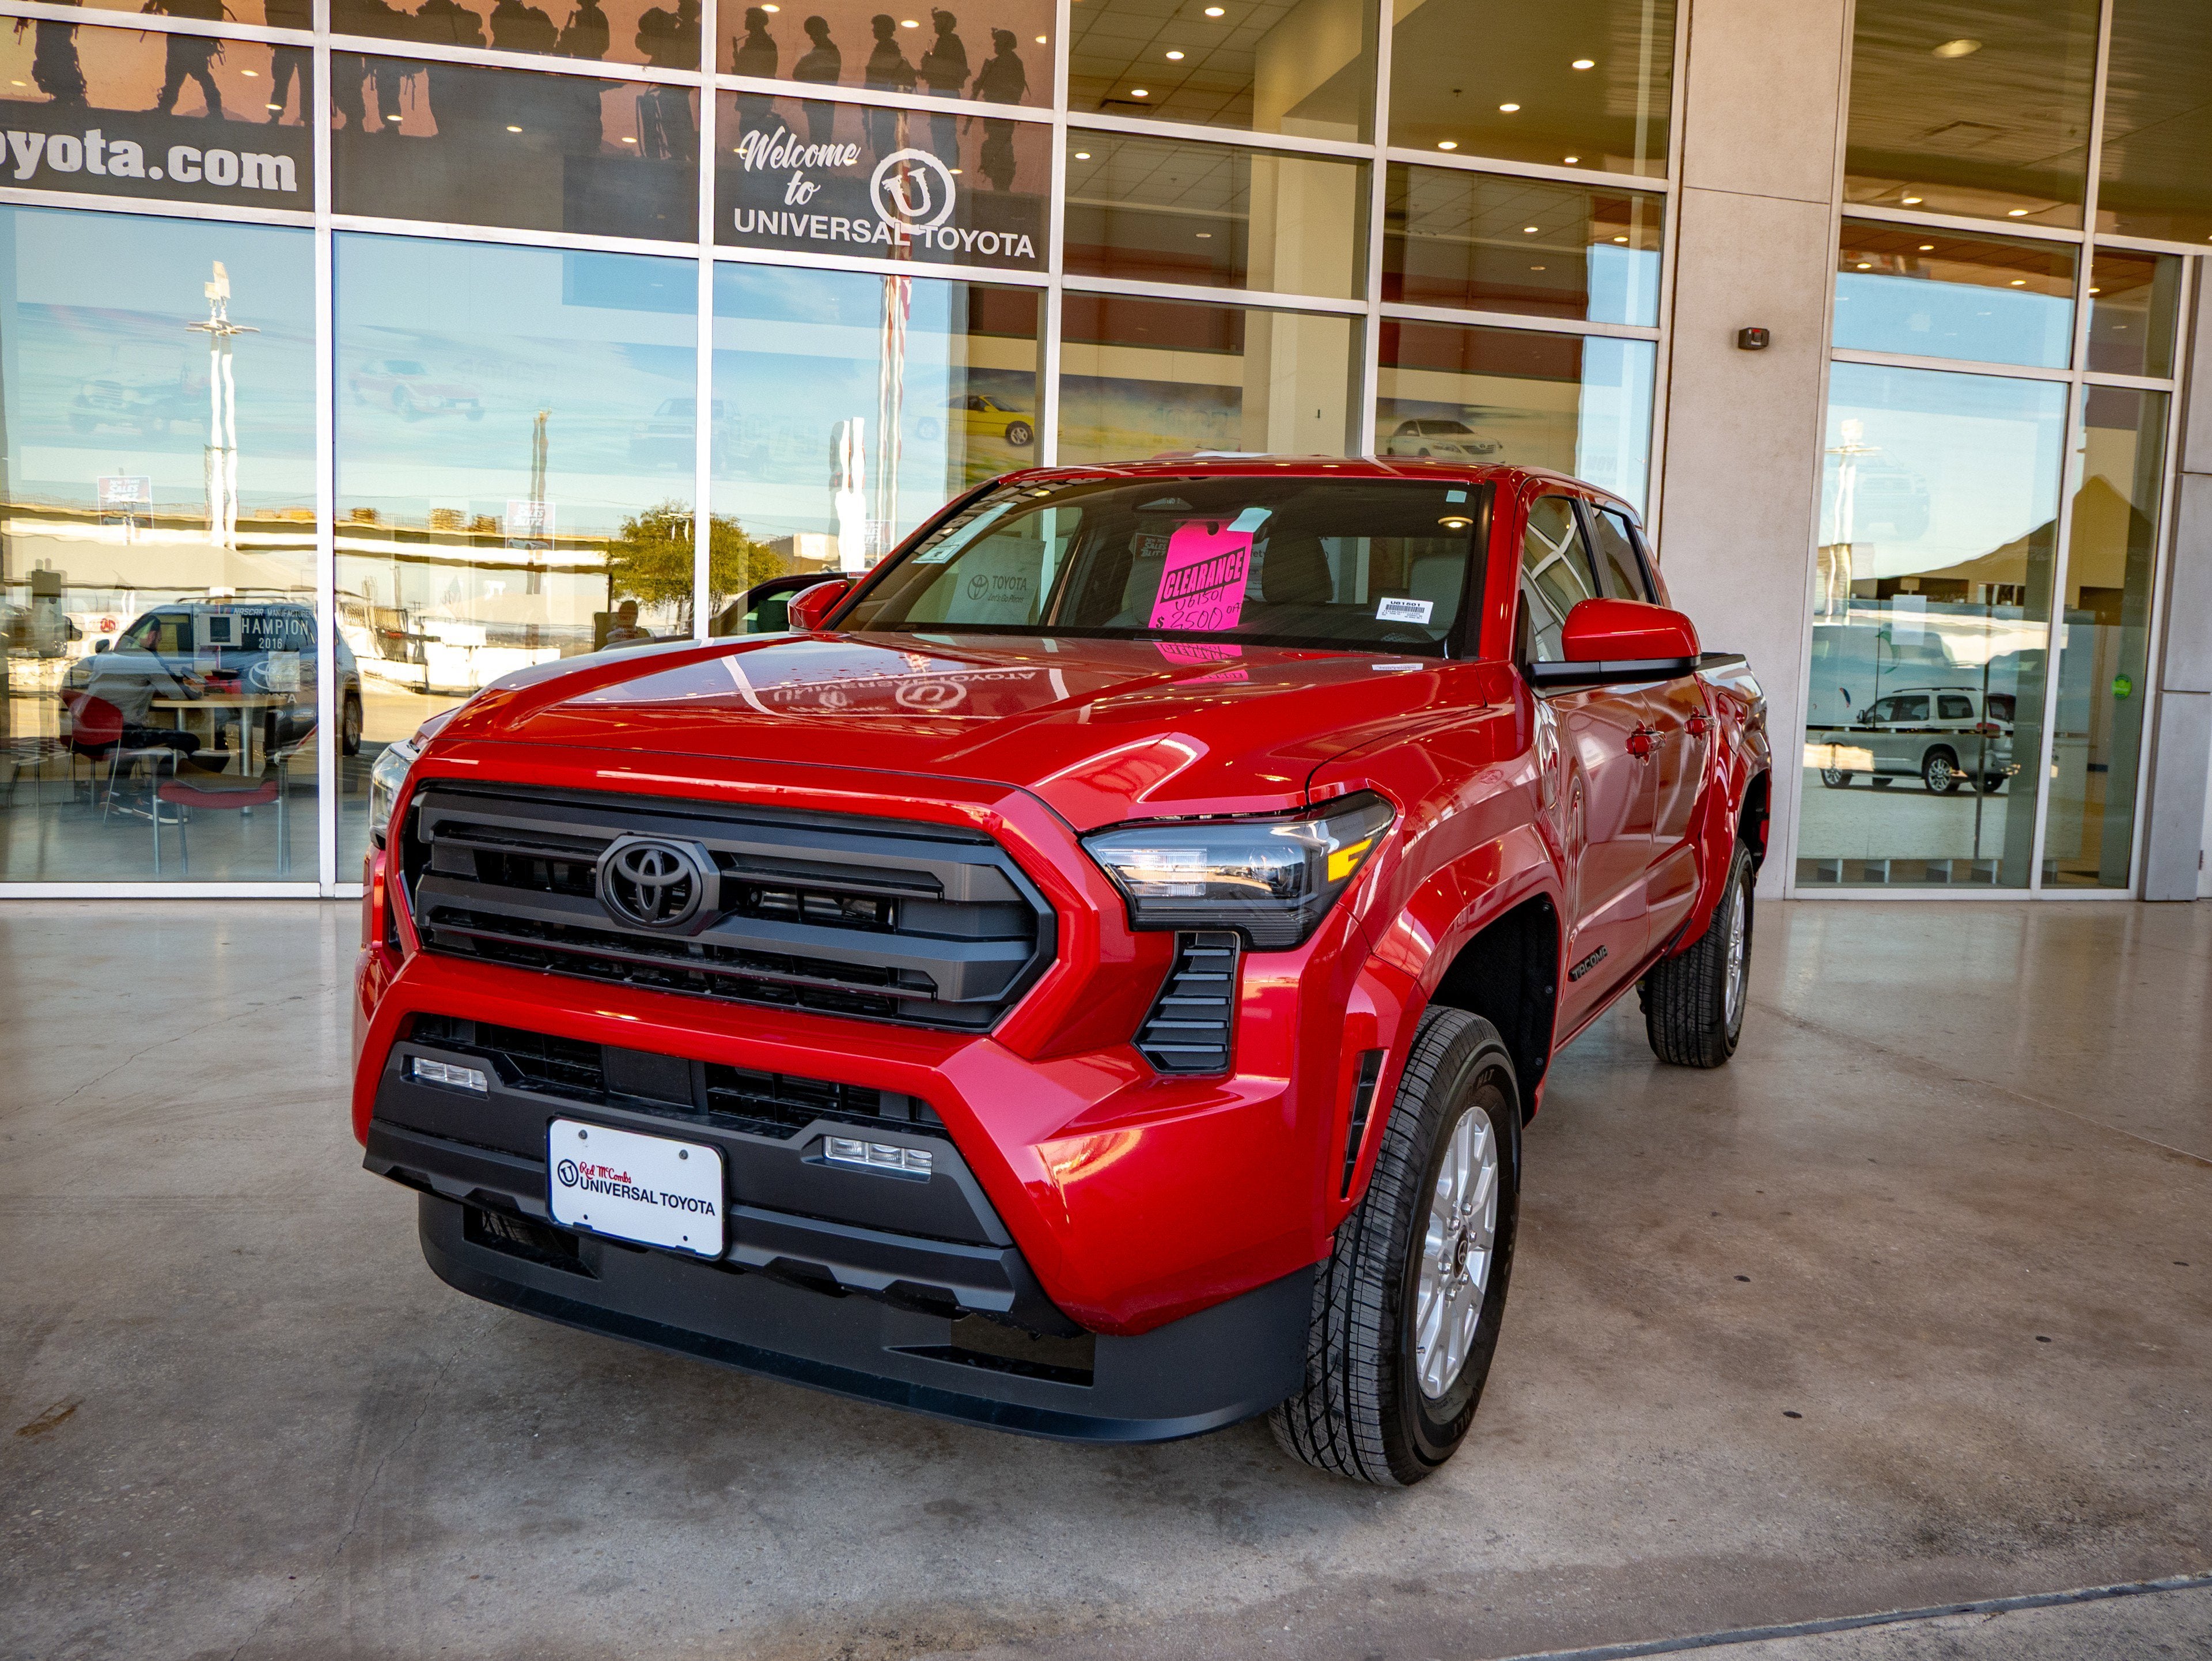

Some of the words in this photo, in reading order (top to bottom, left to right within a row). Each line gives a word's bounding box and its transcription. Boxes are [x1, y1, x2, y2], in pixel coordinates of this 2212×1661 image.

[0, 128, 297, 192] yota.com
[739, 126, 861, 172] Welcome
[785, 171, 821, 206] to
[734, 208, 911, 247] UNIVERSAL
[918, 225, 1036, 259] TOYOTA
[993, 576, 1027, 591] TOYOTA
[1163, 550, 1244, 599] CLEARANCE
[233, 608, 264, 616] NASCAR
[241, 618, 309, 635] HAMPION
[1156, 616, 1165, 629] $
[1171, 607, 1222, 630] 2500
[259, 638, 283, 649] 2016
[1571, 945, 1608, 981] TACOMA
[579, 1161, 595, 1180] Red
[596, 1164, 632, 1184] McCombs
[580, 1176, 658, 1205] UNIVERSAL
[660, 1192, 716, 1216] TOYOTA
